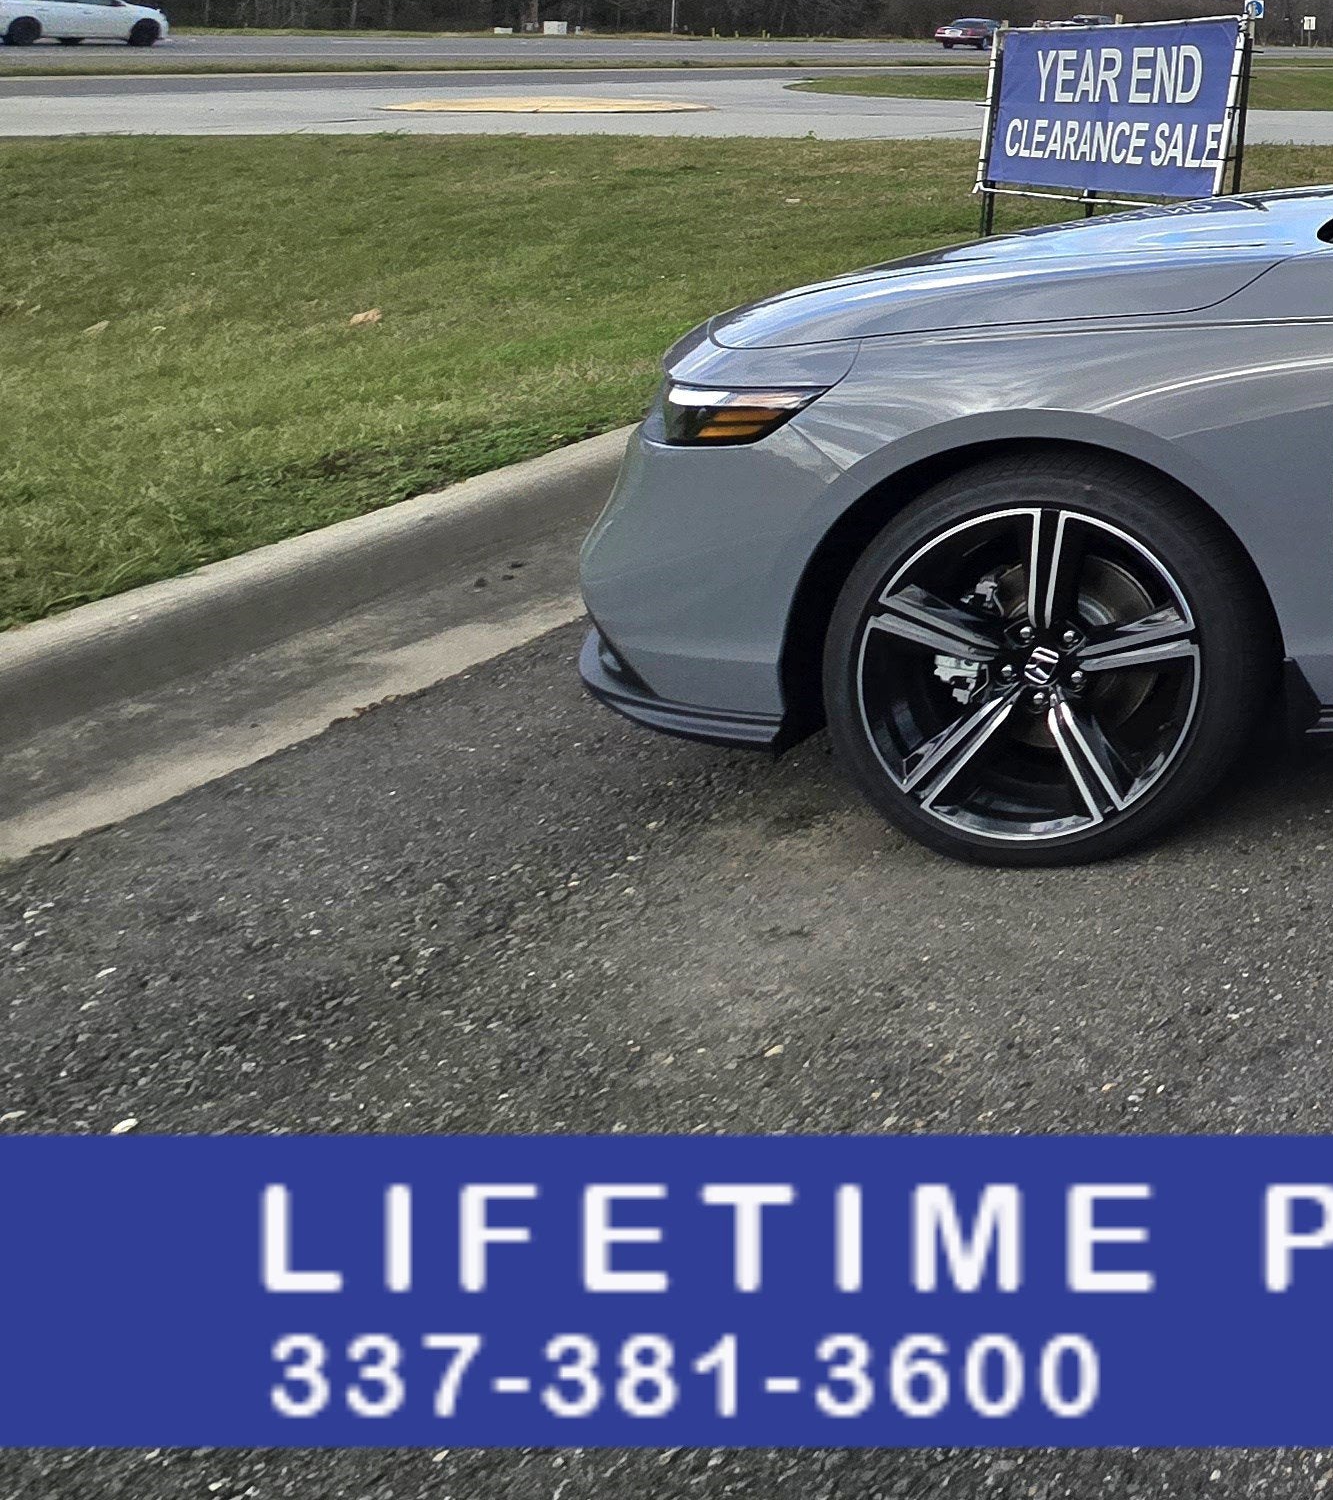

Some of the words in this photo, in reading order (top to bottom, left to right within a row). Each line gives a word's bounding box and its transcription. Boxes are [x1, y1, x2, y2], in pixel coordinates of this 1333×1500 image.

[1037, 46, 1122, 103] YEAR
[1130, 45, 1203, 104] END
[1005, 118, 1149, 167] CLEARANCE
[1150, 122, 1223, 169] SALE
